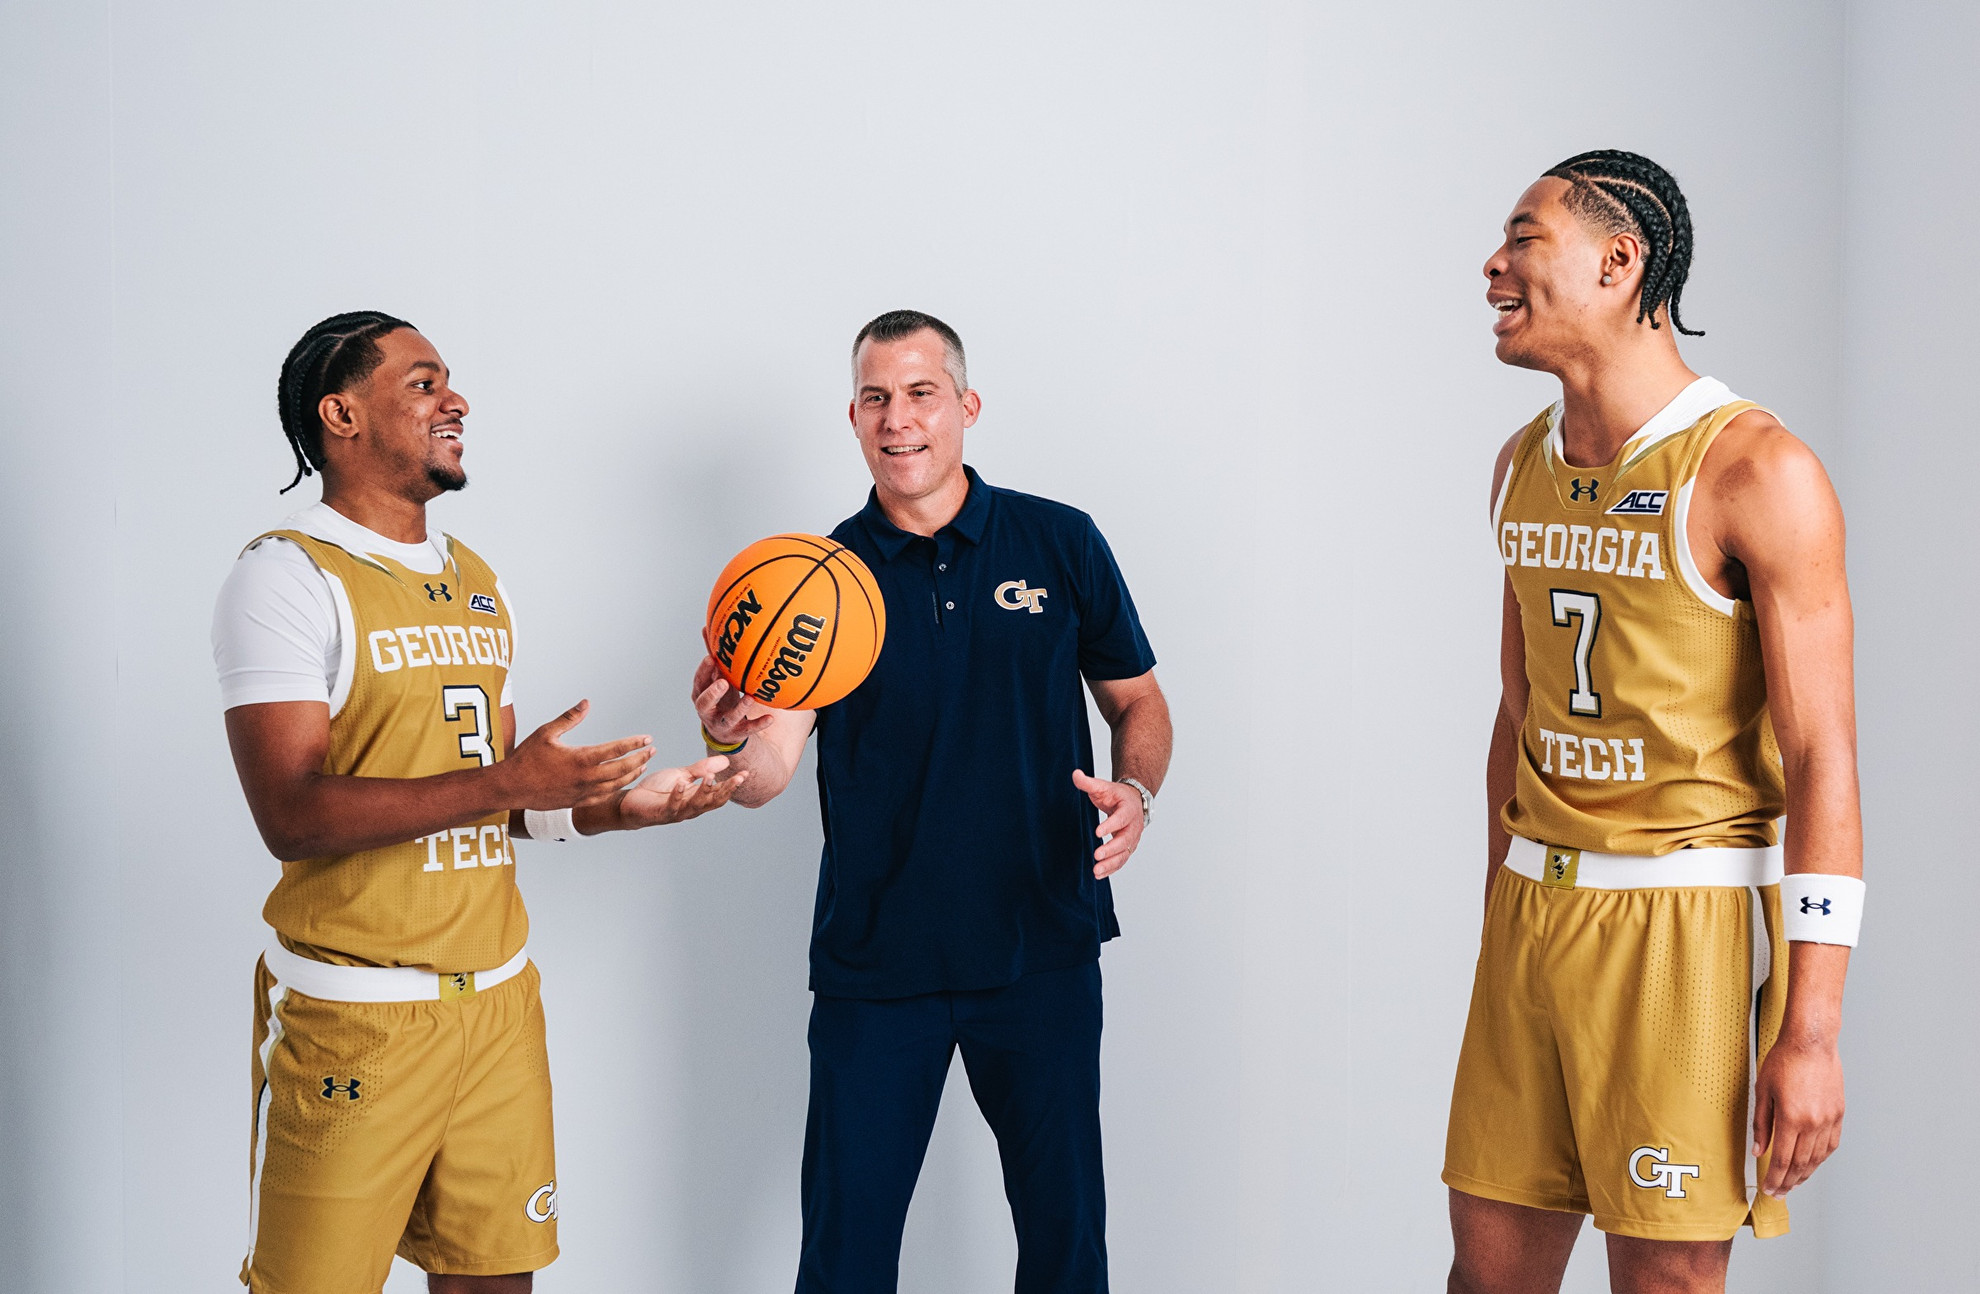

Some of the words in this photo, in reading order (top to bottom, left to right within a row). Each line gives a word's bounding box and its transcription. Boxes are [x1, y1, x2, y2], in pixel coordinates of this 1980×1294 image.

[1615, 491, 1668, 509] ACC
[1501, 521, 1666, 580] GEORGIA
[470, 594, 496, 612] ACC
[994, 579, 1048, 614] GT
[368, 625, 510, 674] GEORGIA
[716, 588, 763, 674] NCAA
[753, 612, 827, 703] Wilson
[1549, 588, 1602, 719] 7
[443, 684, 497, 768] 3
[1539, 727, 1646, 781] TECH
[1628, 1145, 1700, 1198] GT
